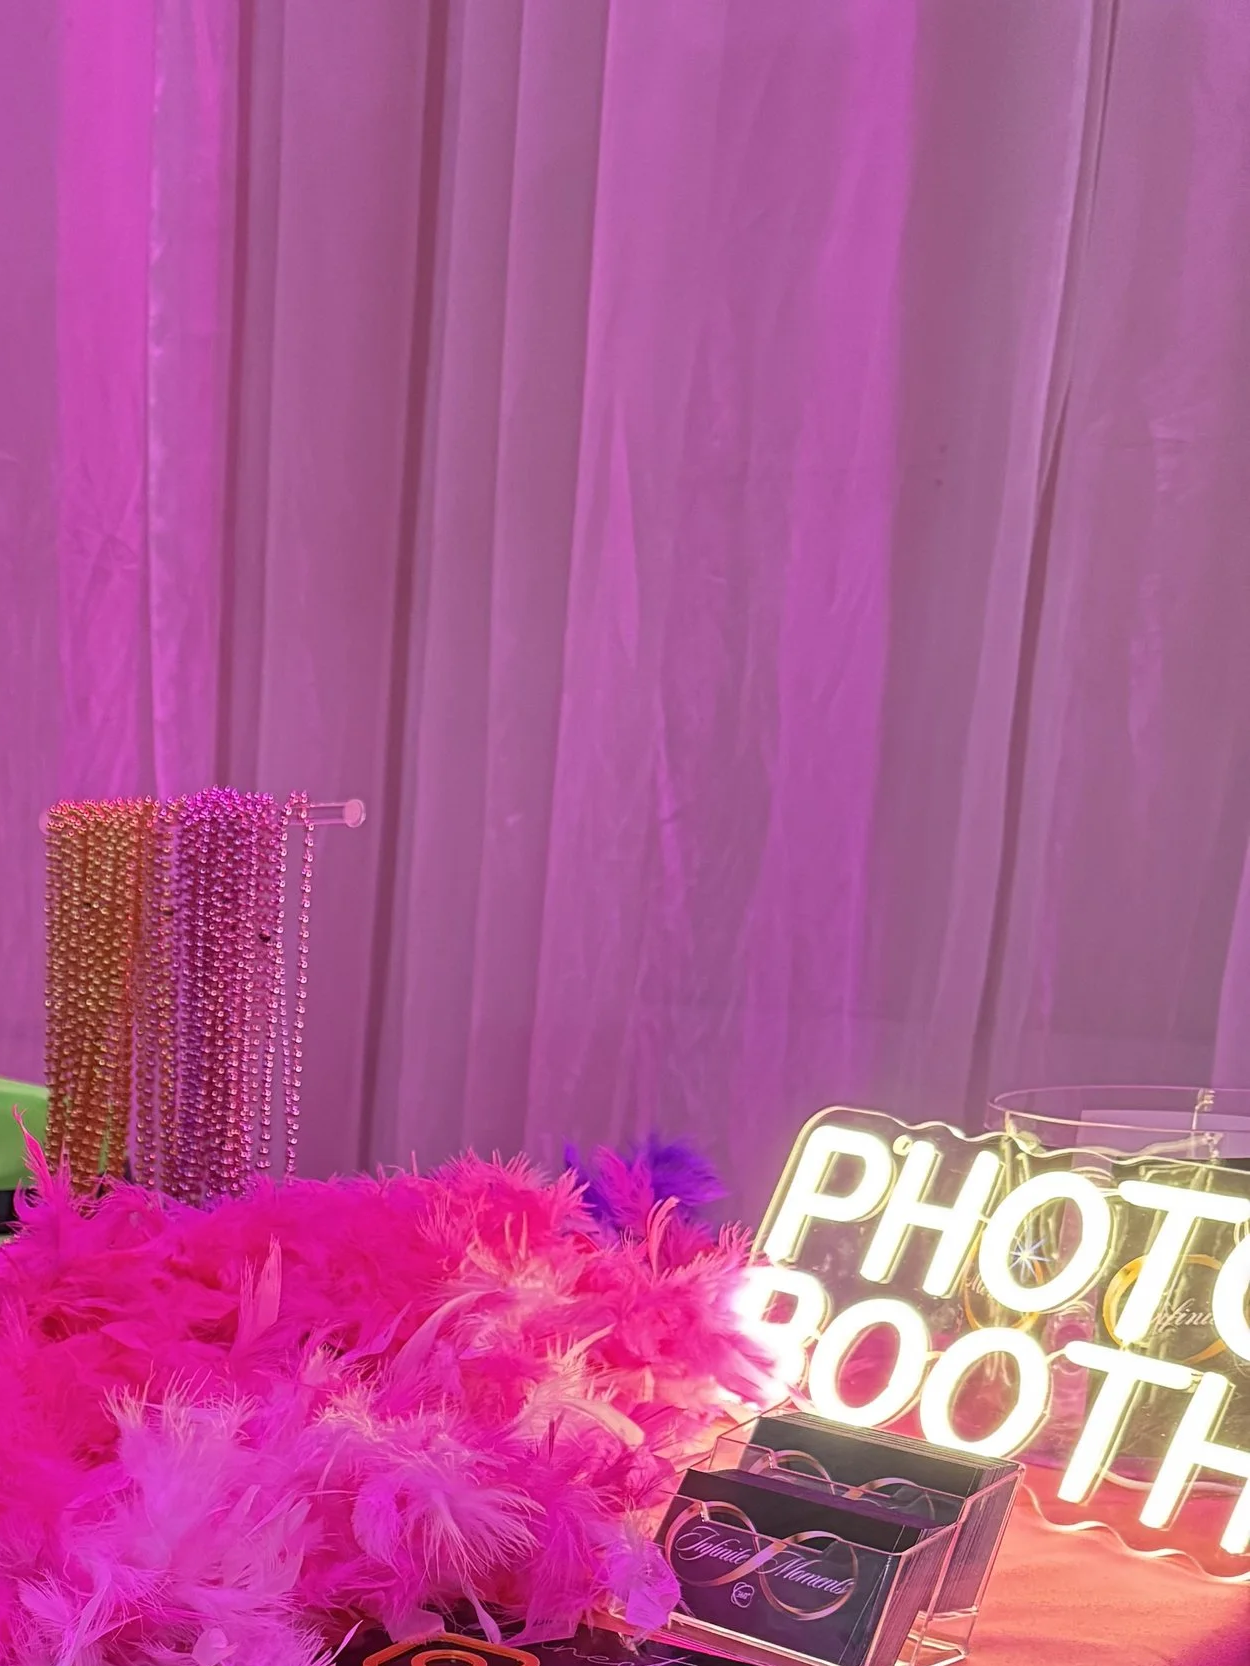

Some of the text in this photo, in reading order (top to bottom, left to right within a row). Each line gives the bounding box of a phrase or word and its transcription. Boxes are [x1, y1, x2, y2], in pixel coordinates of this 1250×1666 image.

[763, 1125, 1250, 1362] PHOT
[722, 1265, 1250, 1556] BOOTH
[674, 1526, 854, 1594] Infinite Moments
